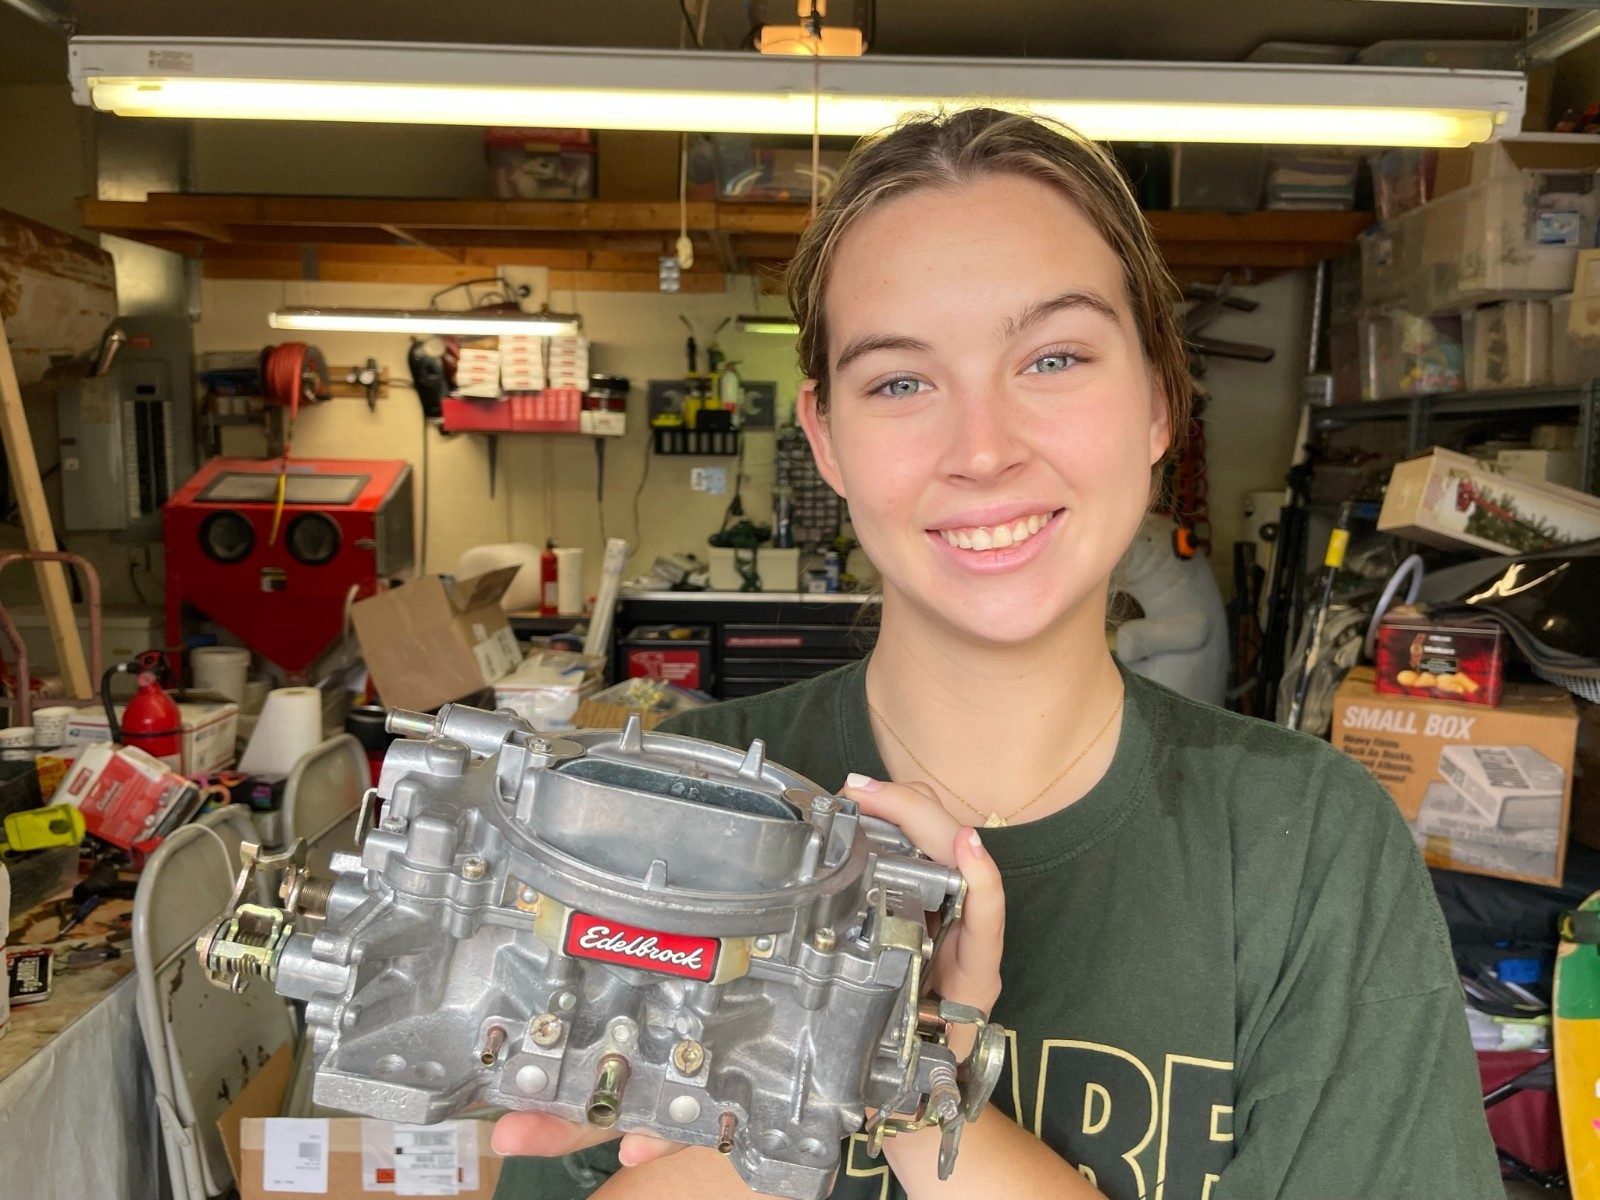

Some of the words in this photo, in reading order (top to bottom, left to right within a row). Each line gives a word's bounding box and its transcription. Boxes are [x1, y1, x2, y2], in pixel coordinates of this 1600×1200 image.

[1342, 705, 1418, 735] SMALL
[1423, 712, 1476, 740] BOX
[579, 925, 703, 970] Edelbrock
